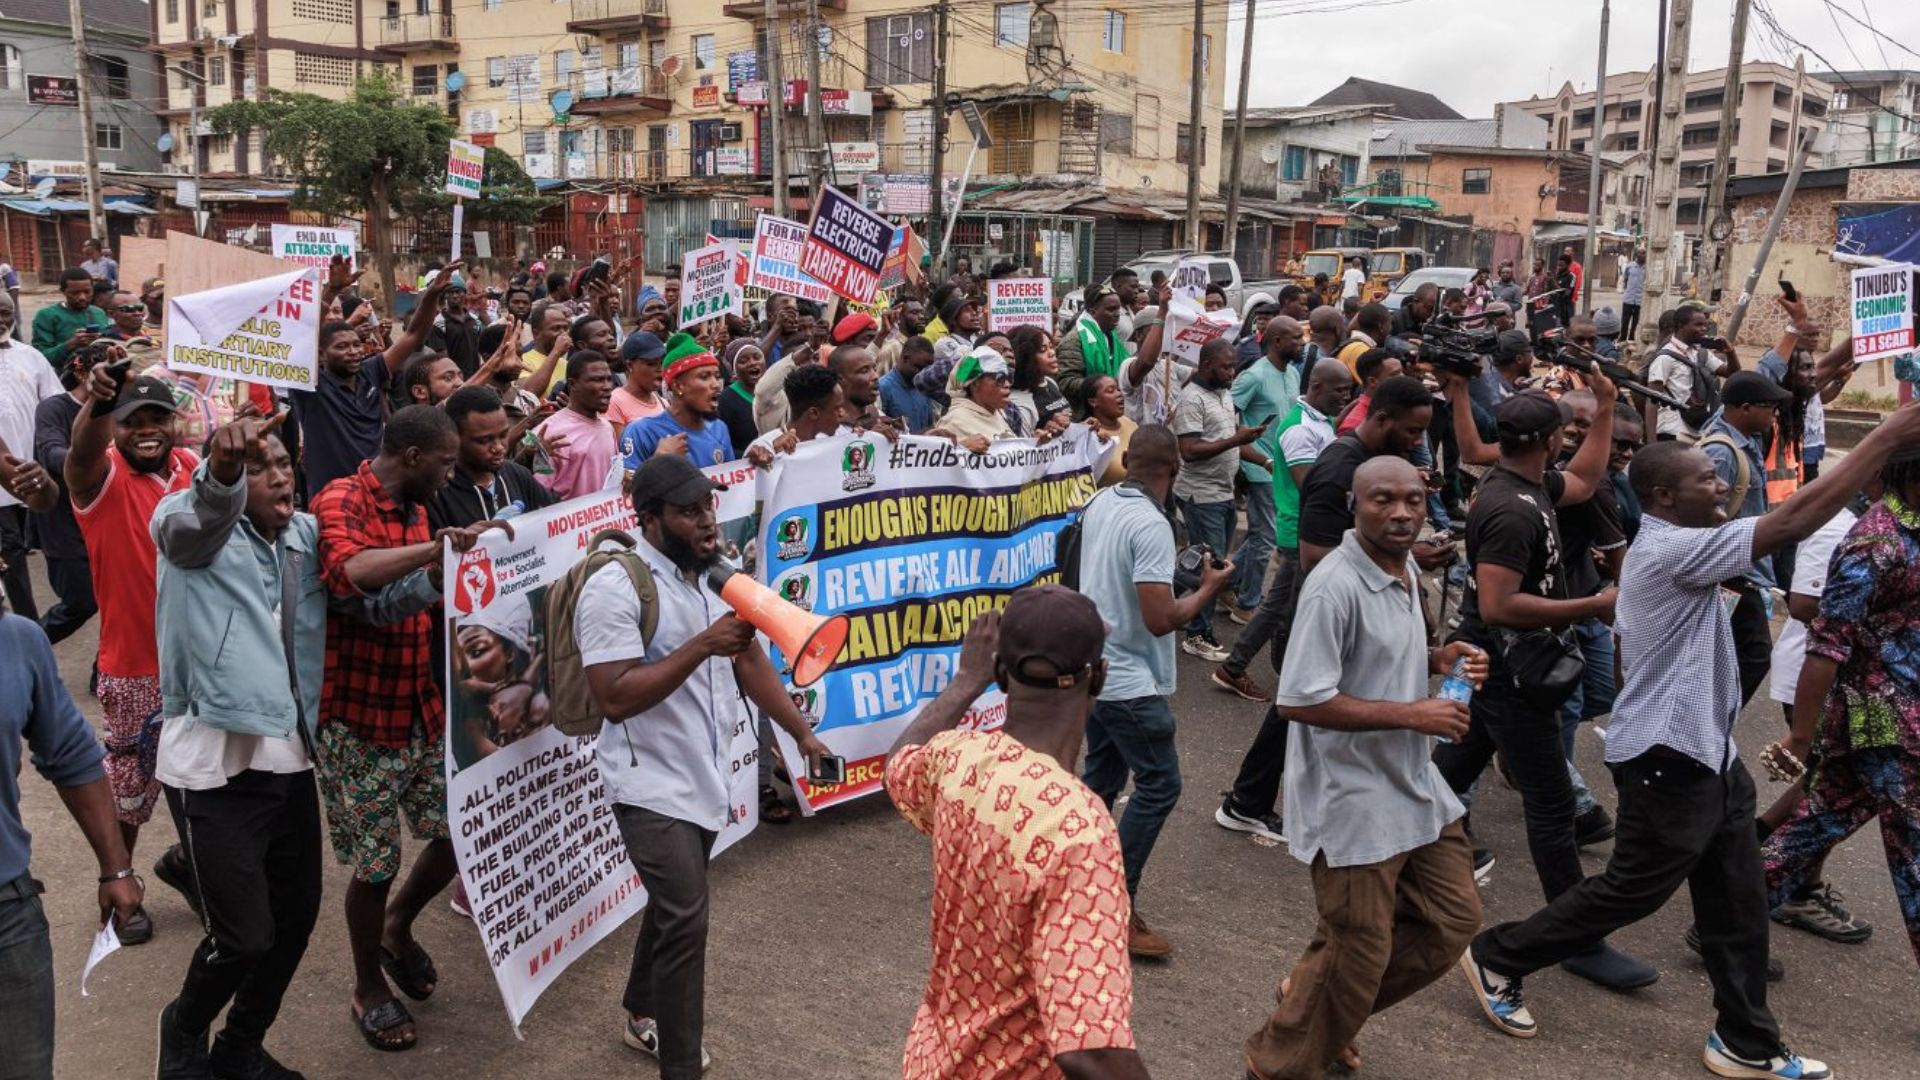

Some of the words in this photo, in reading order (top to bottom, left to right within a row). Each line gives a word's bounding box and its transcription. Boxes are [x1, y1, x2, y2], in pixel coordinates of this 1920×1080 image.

[767, 222, 788, 239] FOR
[789, 228, 805, 243] AN
[831, 200, 882, 245] REVERSE
[285, 242, 333, 256] ATTACKS
[335, 244, 350, 257] ON
[296, 231, 317, 243] END
[320, 232, 337, 244] ALL
[765, 237, 804, 263] GENERA
[814, 215, 884, 269] ELECTRICITY
[686, 259, 731, 283] MOVEMENT
[702, 273, 725, 289] FIGHT
[760, 257, 796, 279] WITH
[804, 241, 847, 287] TARIFF
[843, 264, 879, 307] NOW
[705, 286, 724, 299] BETTER
[754, 272, 802, 295] PROTEST
[803, 283, 830, 300] NOW
[997, 283, 1044, 298] REVERSE
[1854, 270, 1907, 299] TINUBU'S
[276, 299, 300, 321] IN
[996, 298, 1007, 306] ALL
[1856, 294, 1906, 320] ECONOMIC
[1861, 314, 1902, 335] REFORM
[1855, 338, 1867, 355] IS
[1868, 337, 1877, 353] A
[1878, 331, 1910, 352] SCAM
[173, 344, 310, 384] INSTITUTIONS
[546, 499, 615, 539] MOVEMENT
[616, 493, 634, 513] FO
[824, 497, 914, 551] ENOUGH
[911, 494, 928, 536] IS
[930, 488, 1009, 534] ENOUGH
[462, 548, 487, 565] MSA
[494, 545, 536, 569] Movement
[496, 571, 508, 582] for
[509, 568, 515, 578] a
[514, 555, 547, 576] Socialist
[499, 571, 541, 597] Alternative
[824, 550, 940, 611] REVERSE
[944, 547, 982, 589] ALL
[496, 743, 573, 792] POLITICAL
[846, 759, 885, 787] ERC,
[461, 812, 485, 839] ON
[487, 793, 516, 822] THE
[519, 767, 558, 801] SAME
[562, 748, 598, 779] SALA
[474, 794, 549, 857] IMMEDIATE
[551, 767, 600, 804] FIXING
[468, 854, 499, 885] THE
[502, 810, 562, 863] BUILDING
[564, 793, 585, 817] OF
[480, 867, 521, 902] FUEL
[523, 833, 562, 872] PRICE
[562, 813, 589, 843] AND
[592, 802, 613, 823] EL
[477, 875, 536, 930] RETURN
[537, 861, 556, 885] TO
[558, 818, 614, 869] PRE-MAY
[533, 852, 592, 912] PUBLICLY
[594, 833, 623, 861] FUN
[513, 921, 543, 951] ALL
[545, 868, 604, 926] NIGERIAN
